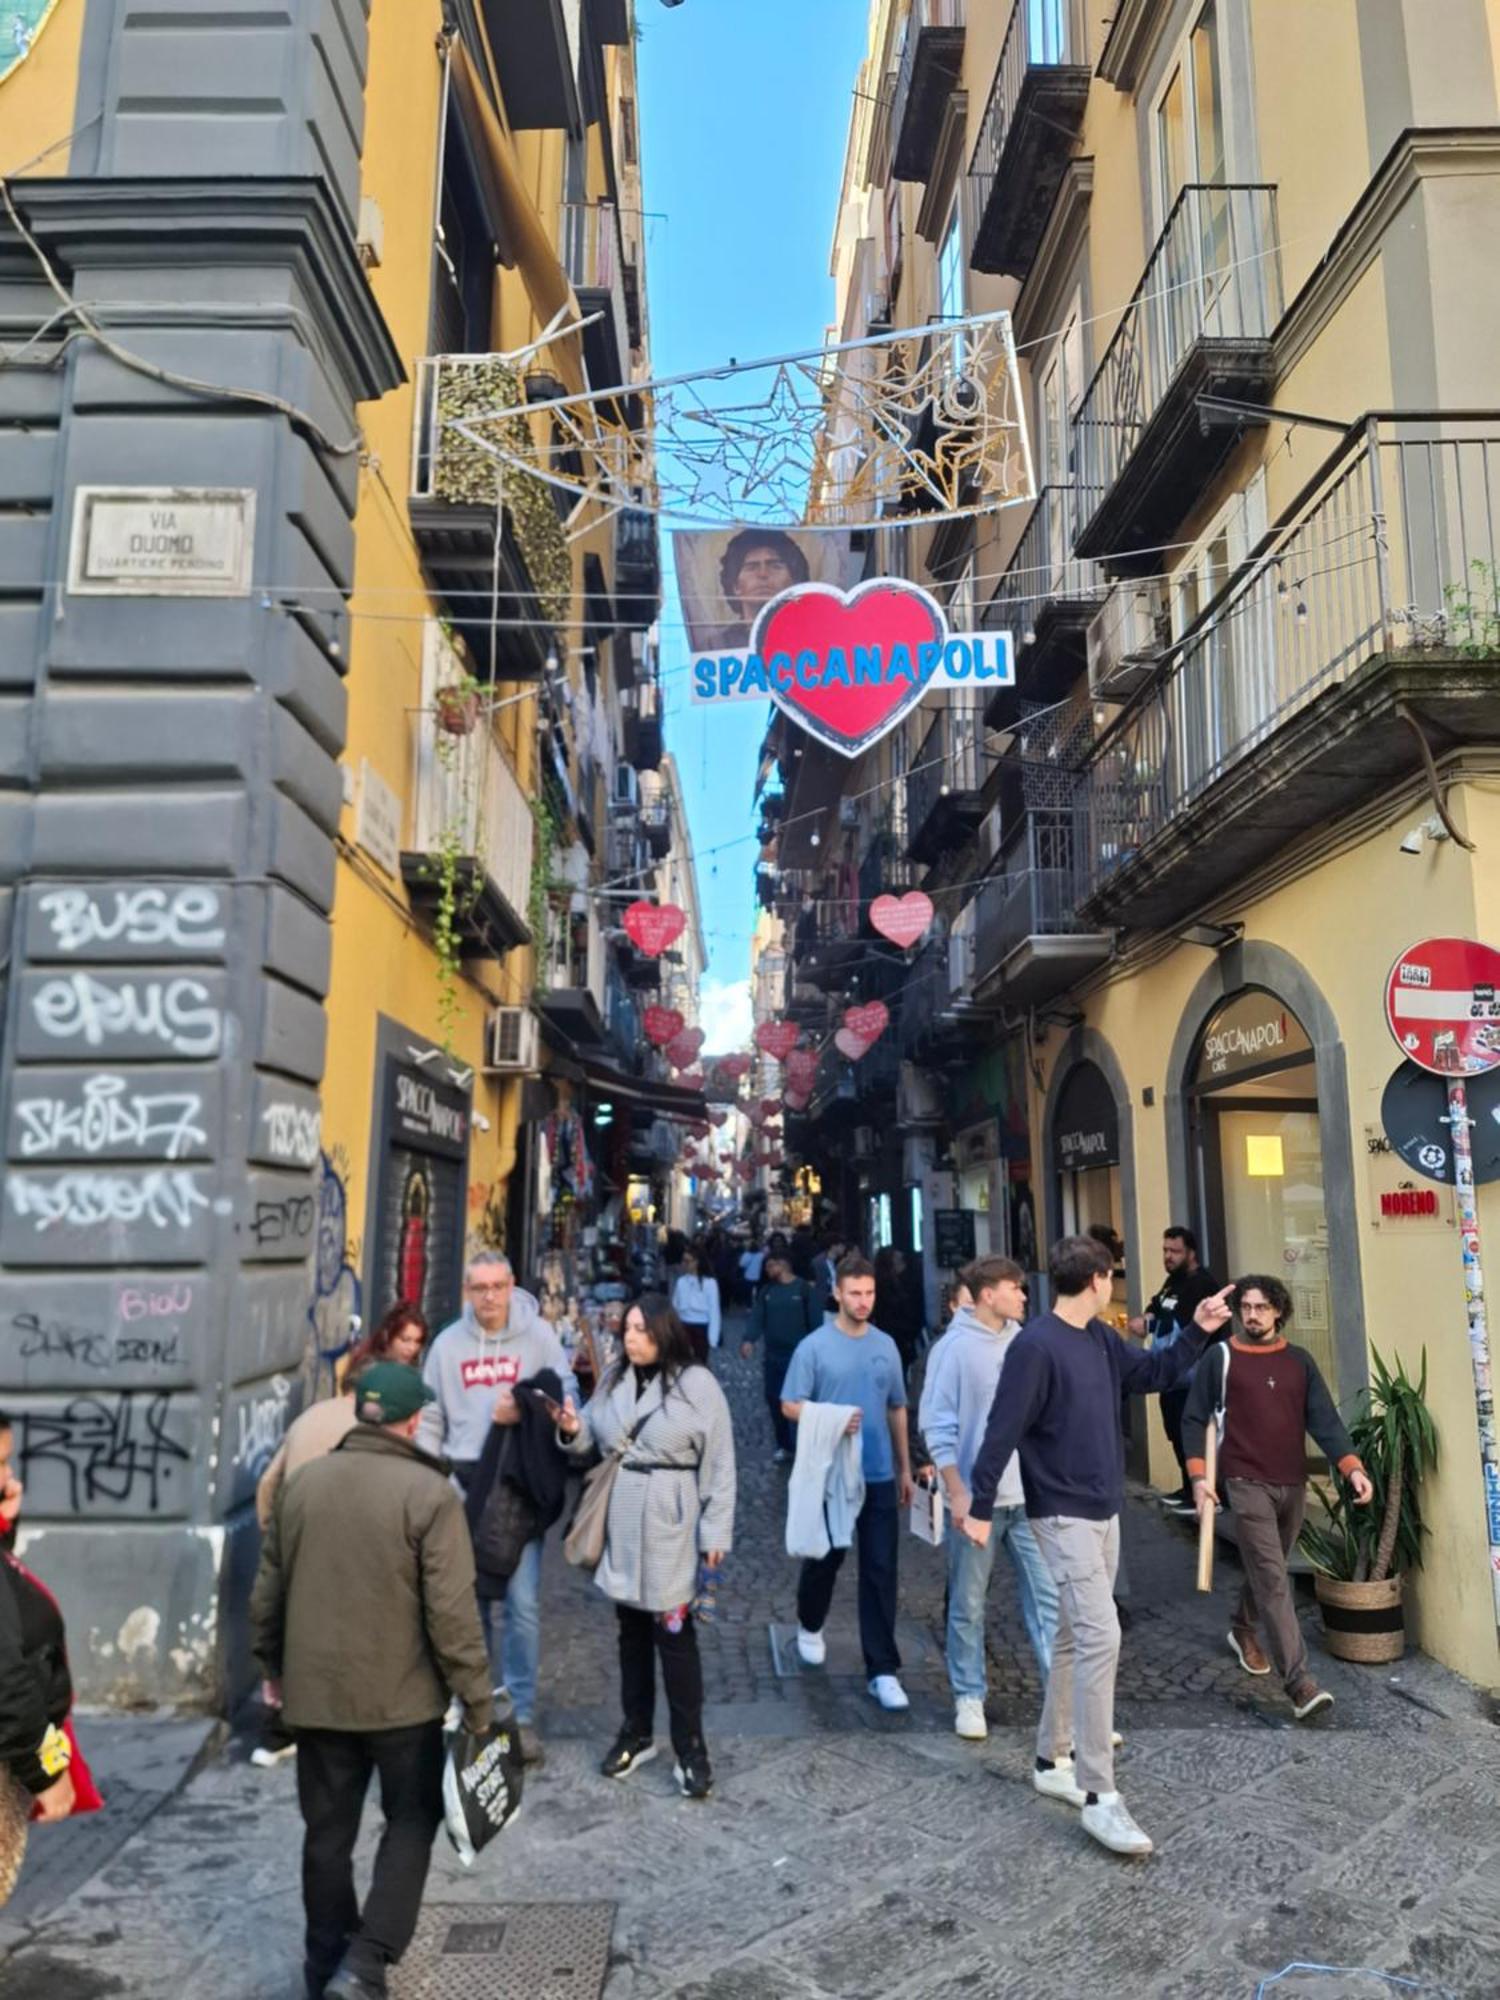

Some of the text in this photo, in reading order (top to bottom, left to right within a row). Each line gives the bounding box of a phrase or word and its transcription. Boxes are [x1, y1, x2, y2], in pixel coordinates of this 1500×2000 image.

[150, 511, 177, 530] VIA
[130, 535, 193, 554] DUOMO
[694, 637, 1009, 697] SPACCANAPOLI
[1381, 1190, 1436, 1216] MORENO
